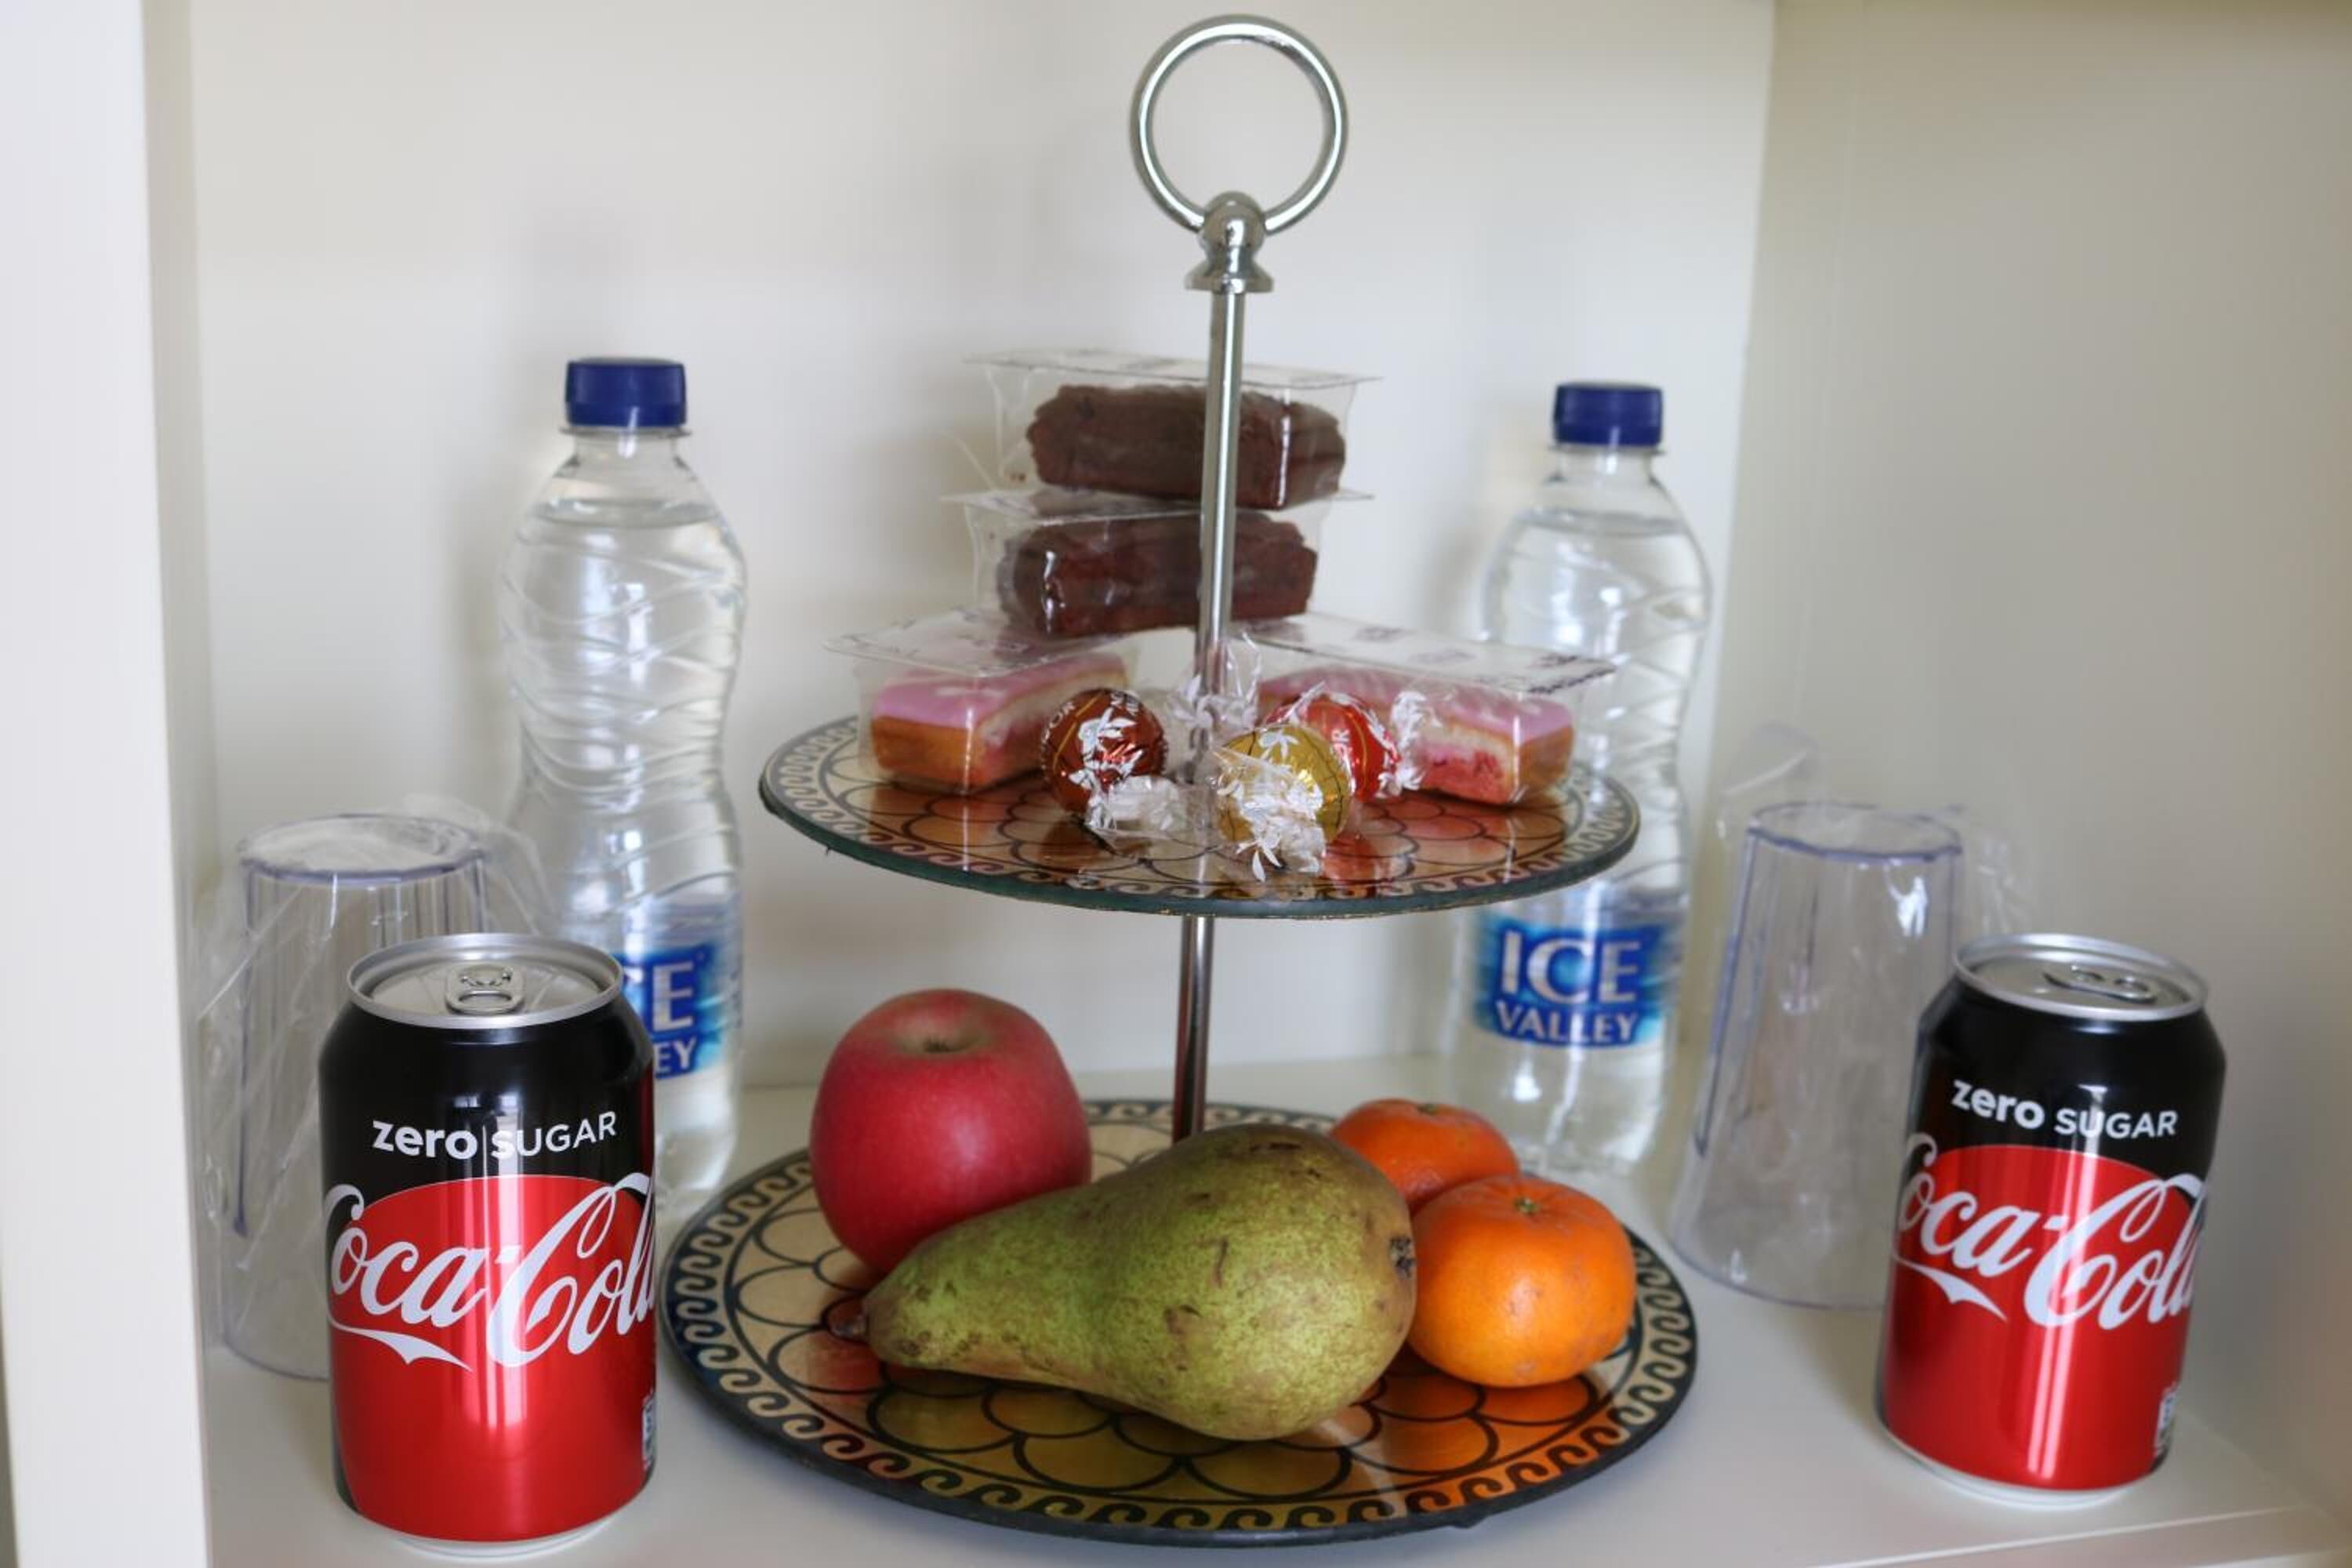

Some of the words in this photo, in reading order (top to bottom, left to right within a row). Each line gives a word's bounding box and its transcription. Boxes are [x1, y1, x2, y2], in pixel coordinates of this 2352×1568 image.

[1501, 930, 1641, 1004] ICE
[1495, 1000, 1637, 1043] VALLEY
[372, 1120, 478, 1160] zero
[491, 1110, 618, 1160] SUGAR
[1951, 1079, 2046, 1130] zero
[2053, 1109, 2180, 1139] SUGAR
